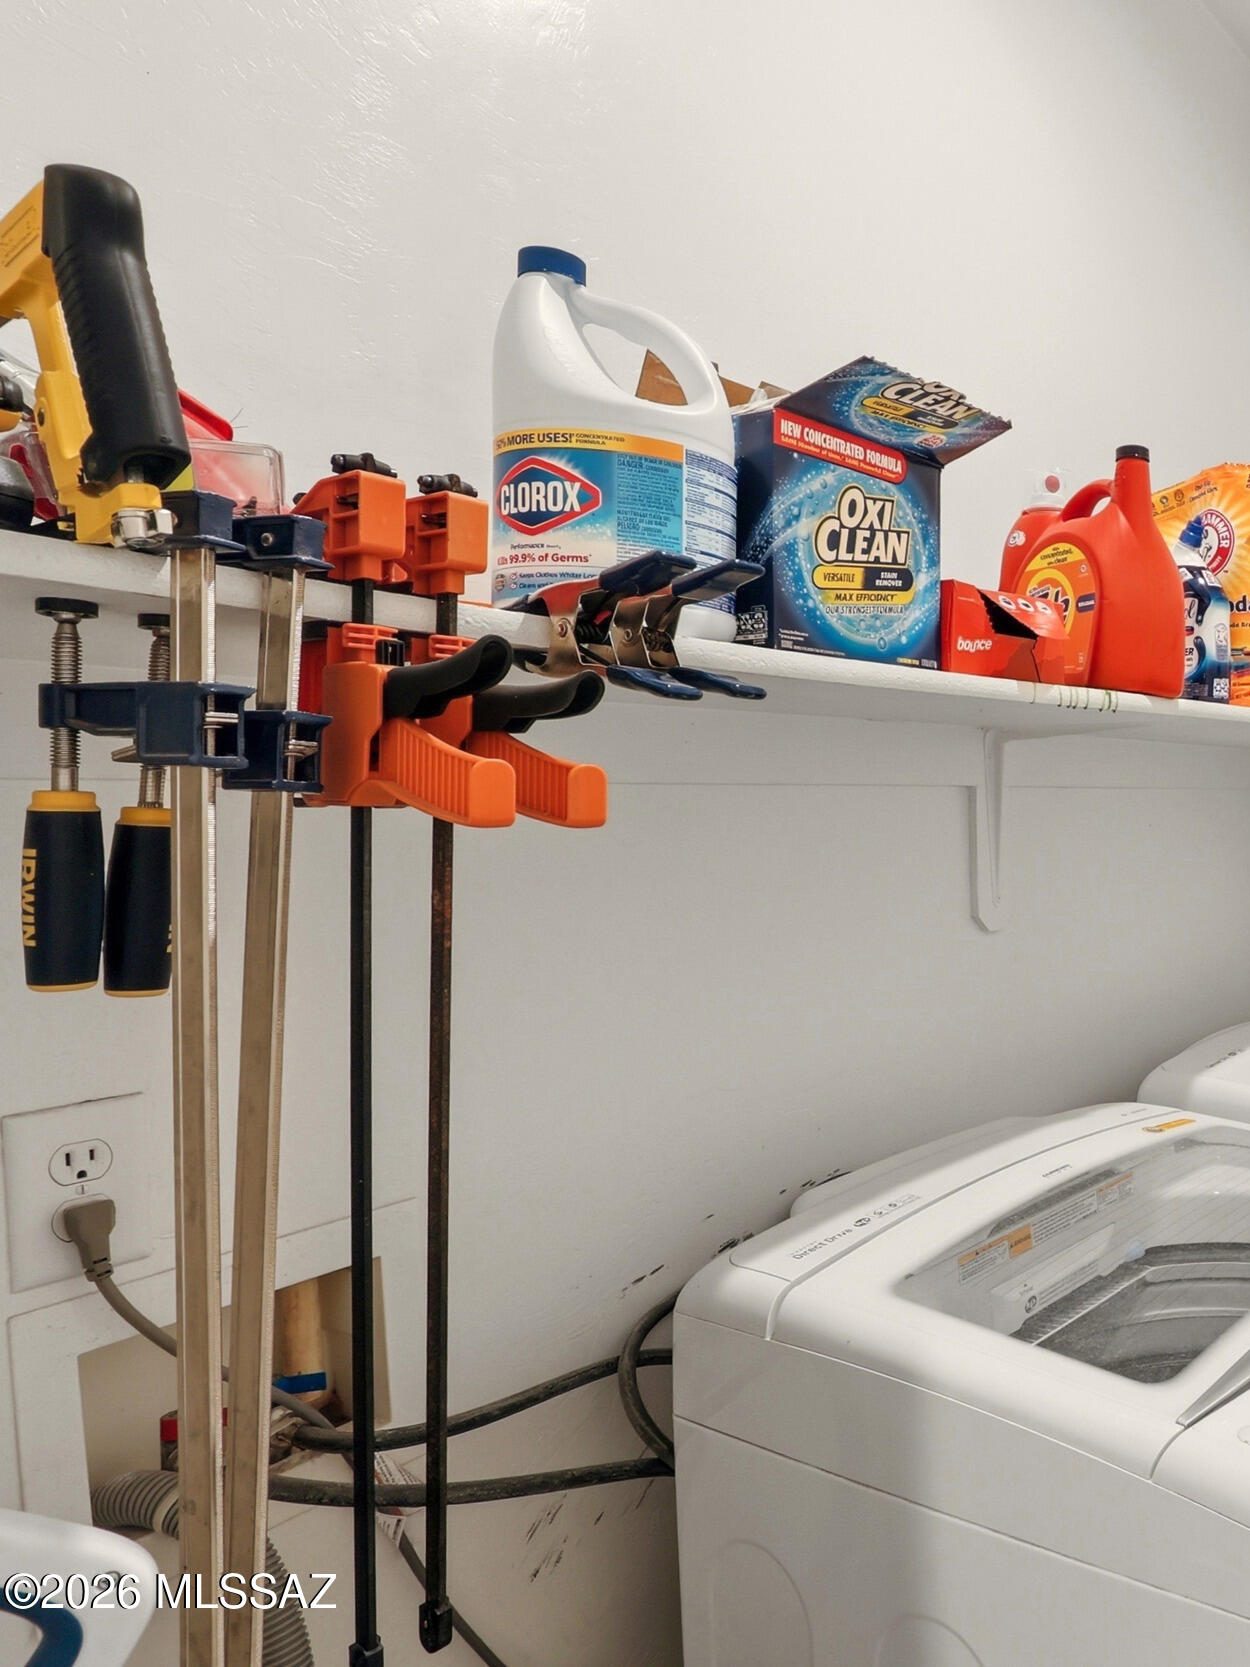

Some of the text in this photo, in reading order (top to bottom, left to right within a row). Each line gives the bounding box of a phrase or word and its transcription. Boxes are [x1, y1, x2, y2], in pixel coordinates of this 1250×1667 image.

[882, 382, 980, 420] CLEAN
[506, 433, 535, 446] MORE
[781, 419, 902, 474] NEW CONCENTRATED FORMULA
[501, 481, 581, 515] CLOROX
[840, 487, 893, 530] OXI
[816, 518, 909, 564] CLEAN
[1202, 513, 1231, 548] AMMER
[509, 553, 535, 564] 99.9%
[538, 553, 549, 562] of
[823, 572, 855, 582] VERSATILE
[834, 593, 854, 602] MAX
[957, 635, 993, 653] bounce
[21, 848, 37, 947] IRWIN
